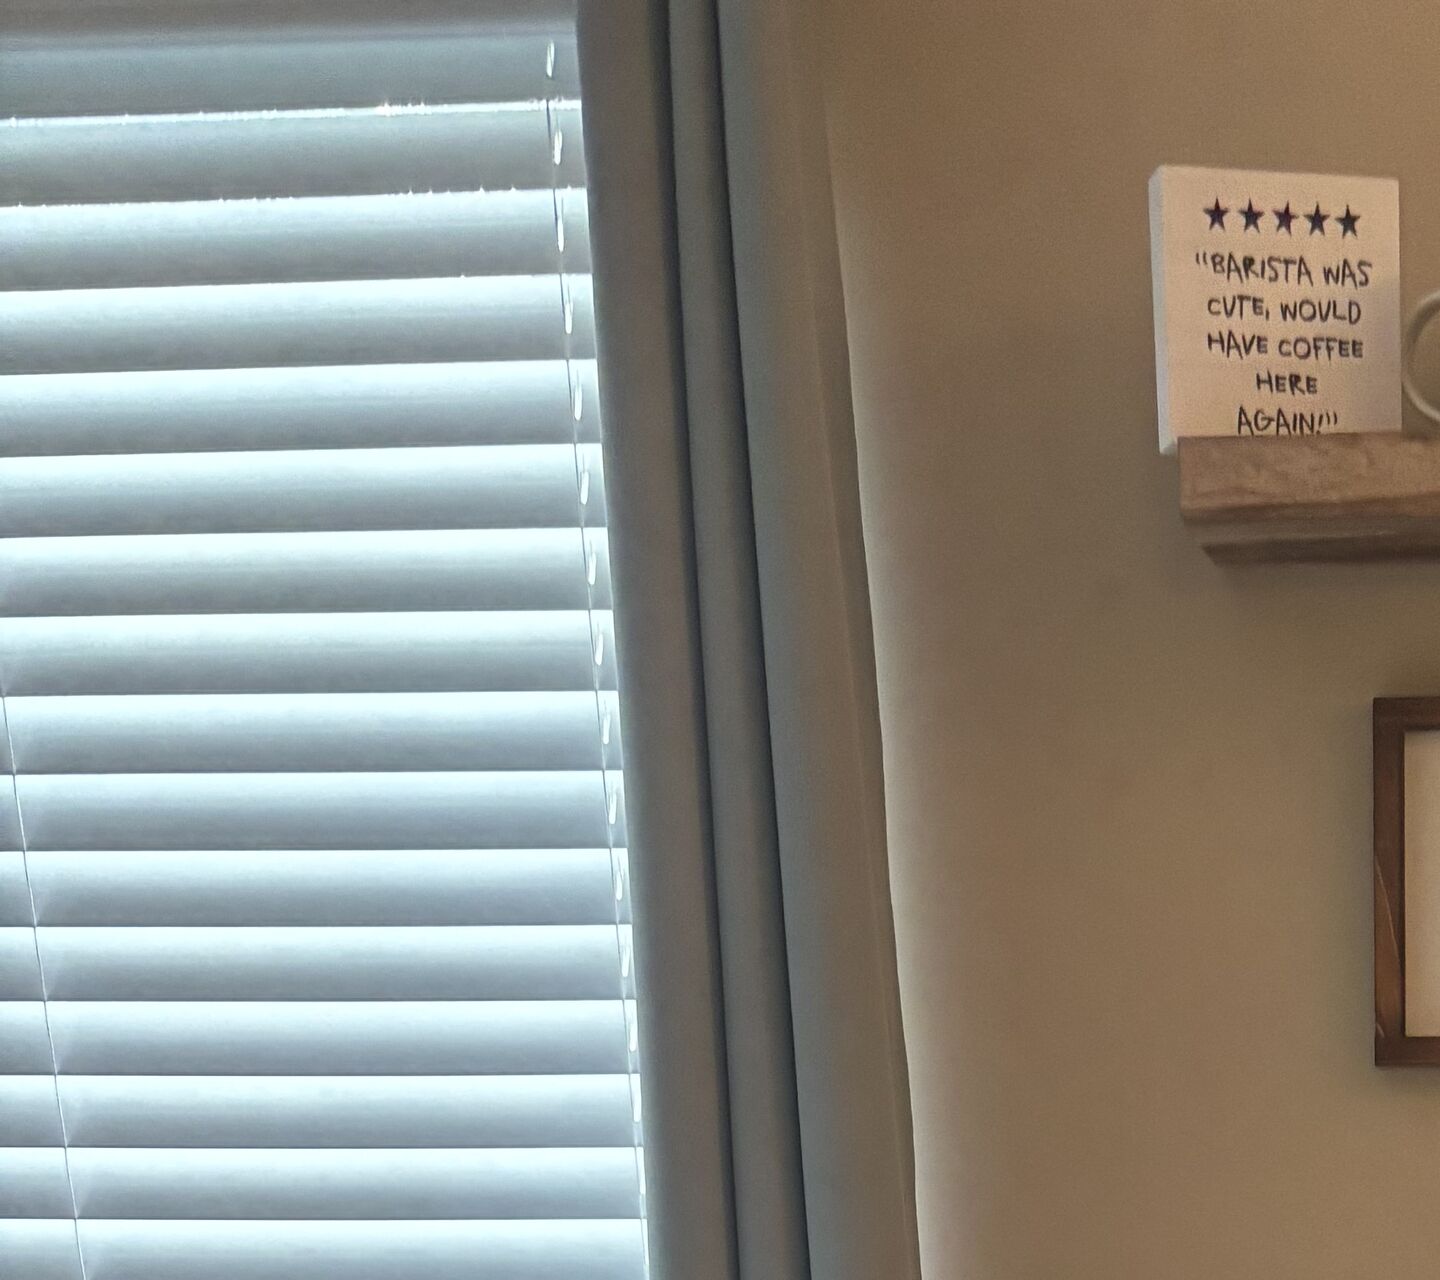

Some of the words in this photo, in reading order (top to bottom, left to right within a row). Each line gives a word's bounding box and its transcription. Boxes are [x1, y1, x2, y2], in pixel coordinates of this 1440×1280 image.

[1323, 258, 1372, 290] WAS
[1207, 294, 1270, 321] CUTE,
[1280, 300, 1362, 325] WOULD
[1207, 329, 1268, 360] HAVE
[1278, 336, 1364, 361] COFFEE
[1256, 370, 1318, 396] HERE
